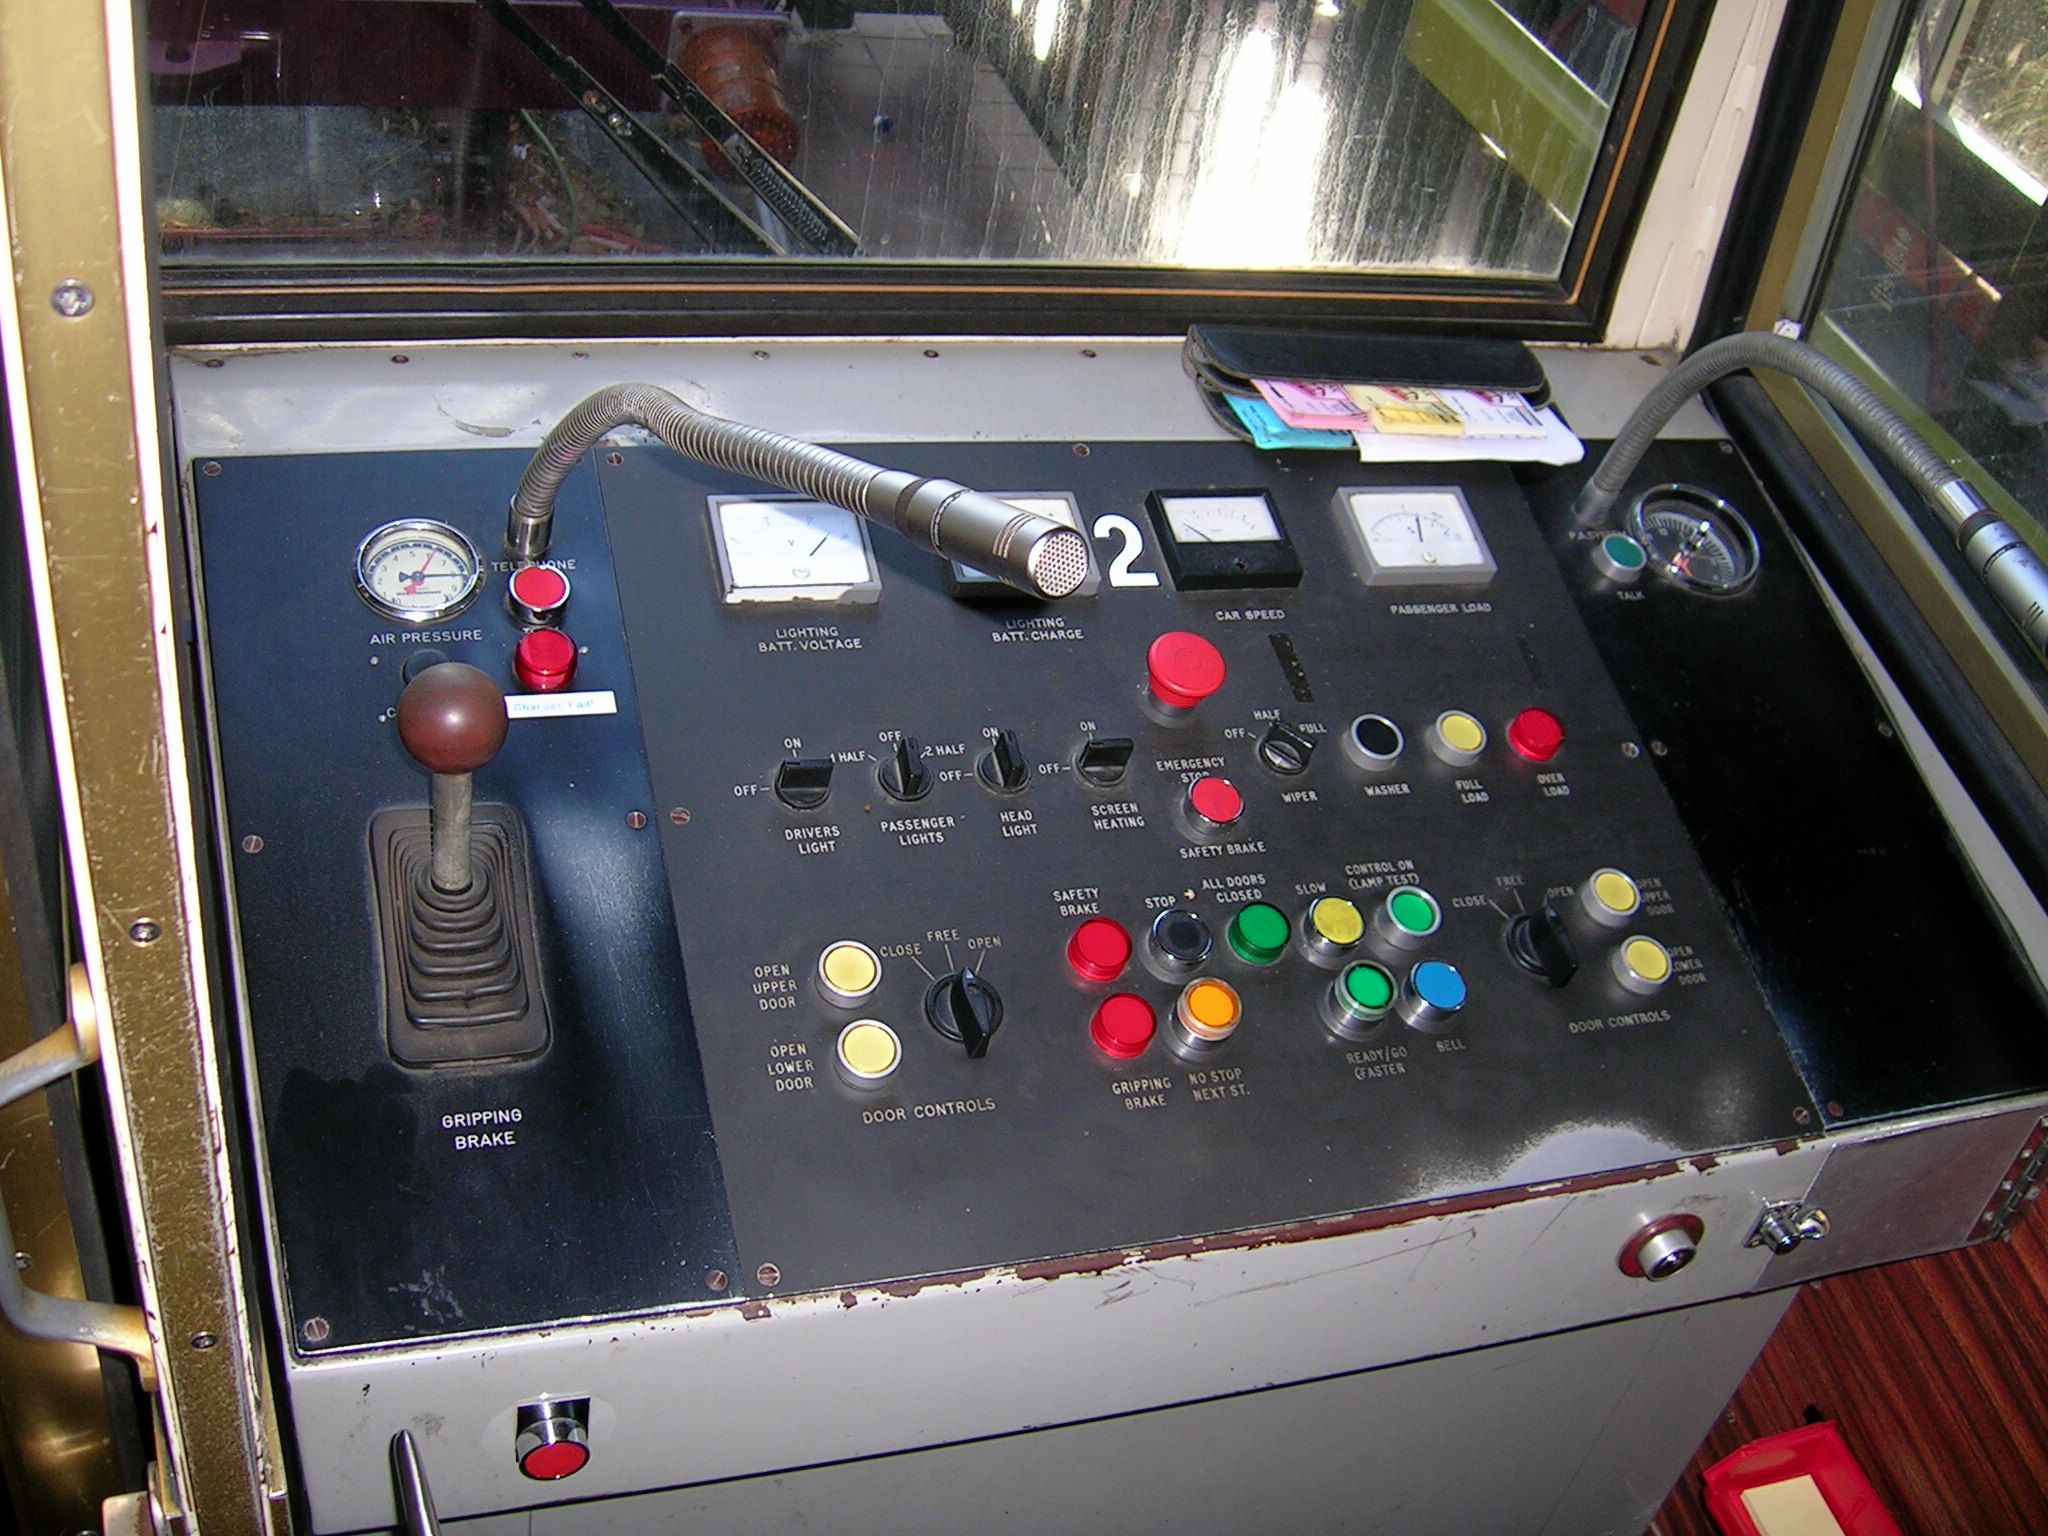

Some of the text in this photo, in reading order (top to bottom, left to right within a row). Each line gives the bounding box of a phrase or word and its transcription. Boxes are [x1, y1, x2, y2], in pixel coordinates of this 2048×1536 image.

[1093, 513, 1160, 587] 2
[1616, 590, 1645, 601] TALK
[1215, 608, 1286, 622] CAR SPEED
[1389, 603, 1492, 615] PASSENGER LOAD
[1005, 616, 1065, 630] LIGHTING
[369, 629, 483, 645] AIR PRESSURE
[775, 626, 839, 639] LIGHTING
[1033, 628, 1085, 642] CHARGE
[799, 637, 863, 651] VOLTAGE
[1253, 709, 1281, 721] HALF
[982, 726, 999, 738] ON
[1079, 720, 1097, 732] ON
[1299, 723, 1327, 735] FULL
[878, 730, 902, 743] OFF
[1224, 728, 1246, 740] OFF
[783, 737, 802, 749] ON
[925, 743, 967, 757] 2 HALF
[838, 750, 867, 763] HALF
[1038, 762, 1061, 775] OFF
[1155, 756, 1226, 772] EMERGENCY
[939, 769, 963, 783] OFF
[1536, 773, 1567, 785] OVER
[733, 784, 758, 797] OFF
[1364, 783, 1412, 797] WASHER
[1455, 779, 1484, 791] FULL
[1544, 785, 1571, 798] LOAD
[1281, 790, 1319, 803] WIPER
[1461, 791, 1489, 804] LOAD
[1000, 809, 1033, 823] HEAD
[1090, 801, 1140, 818] SCREEN
[880, 816, 956, 832] PASSENGER
[1093, 815, 1146, 831] HEATING
[784, 825, 841, 841] DRIVERS
[1001, 823, 1039, 838] LIGHT
[900, 832, 945, 846] LIGHTS
[798, 841, 836, 855] LIGHT
[1179, 841, 1267, 860] SAFETY BRAKE
[1344, 859, 1415, 876] CONTROL ON
[1201, 873, 1267, 890] ALL DOORS
[1052, 887, 1100, 903] SAFETY
[1216, 888, 1263, 904] CLOSED
[1295, 882, 1327, 896] SLOW
[1144, 895, 1177, 910] STOP
[1453, 894, 1488, 908] CLOSE
[1059, 902, 1101, 917] BRAKE
[926, 928, 960, 943] FREE
[879, 942, 923, 958] CLOSE
[967, 936, 1002, 950] OPEN
[754, 964, 791, 978] OPEN
[752, 979, 798, 995] UPPER
[759, 996, 797, 1011] DOOR
[1568, 1009, 1672, 1034] DOOR CONTROLS
[770, 1043, 807, 1058] OPEN
[1436, 1038, 1467, 1053] BELL
[1345, 1045, 1408, 1065] READY/GO
[767, 1060, 815, 1076] LOWER
[1188, 1067, 1243, 1085] NO STOP
[775, 1076, 814, 1092] DOOR
[1111, 1076, 1173, 1095] GRIPPING
[1192, 1083, 1250, 1101] NEXT ST.
[1124, 1093, 1168, 1111] BRAKE
[441, 1107, 523, 1129] GRIPPING
[862, 1097, 997, 1125] DOOR CONTROLS
[454, 1131, 516, 1150] BRAKE
